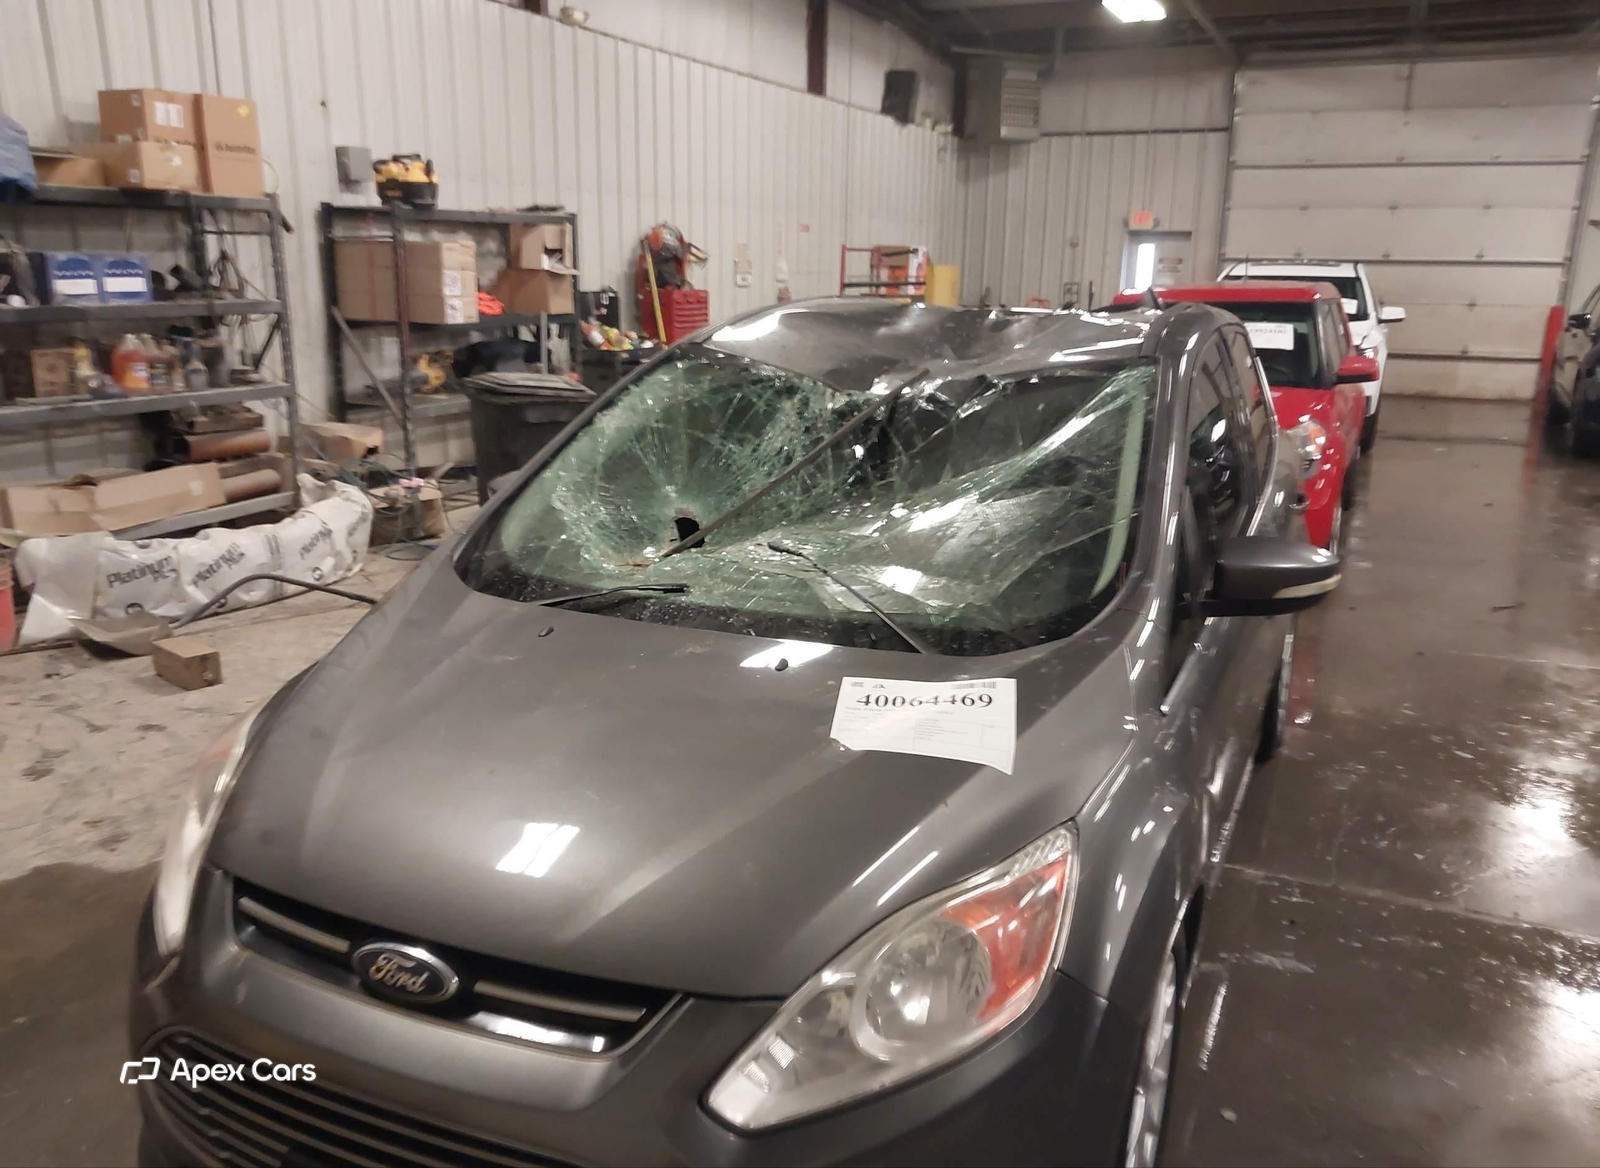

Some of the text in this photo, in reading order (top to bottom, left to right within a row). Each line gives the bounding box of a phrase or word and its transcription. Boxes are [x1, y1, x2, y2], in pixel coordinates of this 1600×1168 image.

[106, 556, 174, 588] Platinum
[192, 542, 240, 588] Platinum
[855, 692, 994, 708] 40064469
[368, 952, 430, 993] Ford
